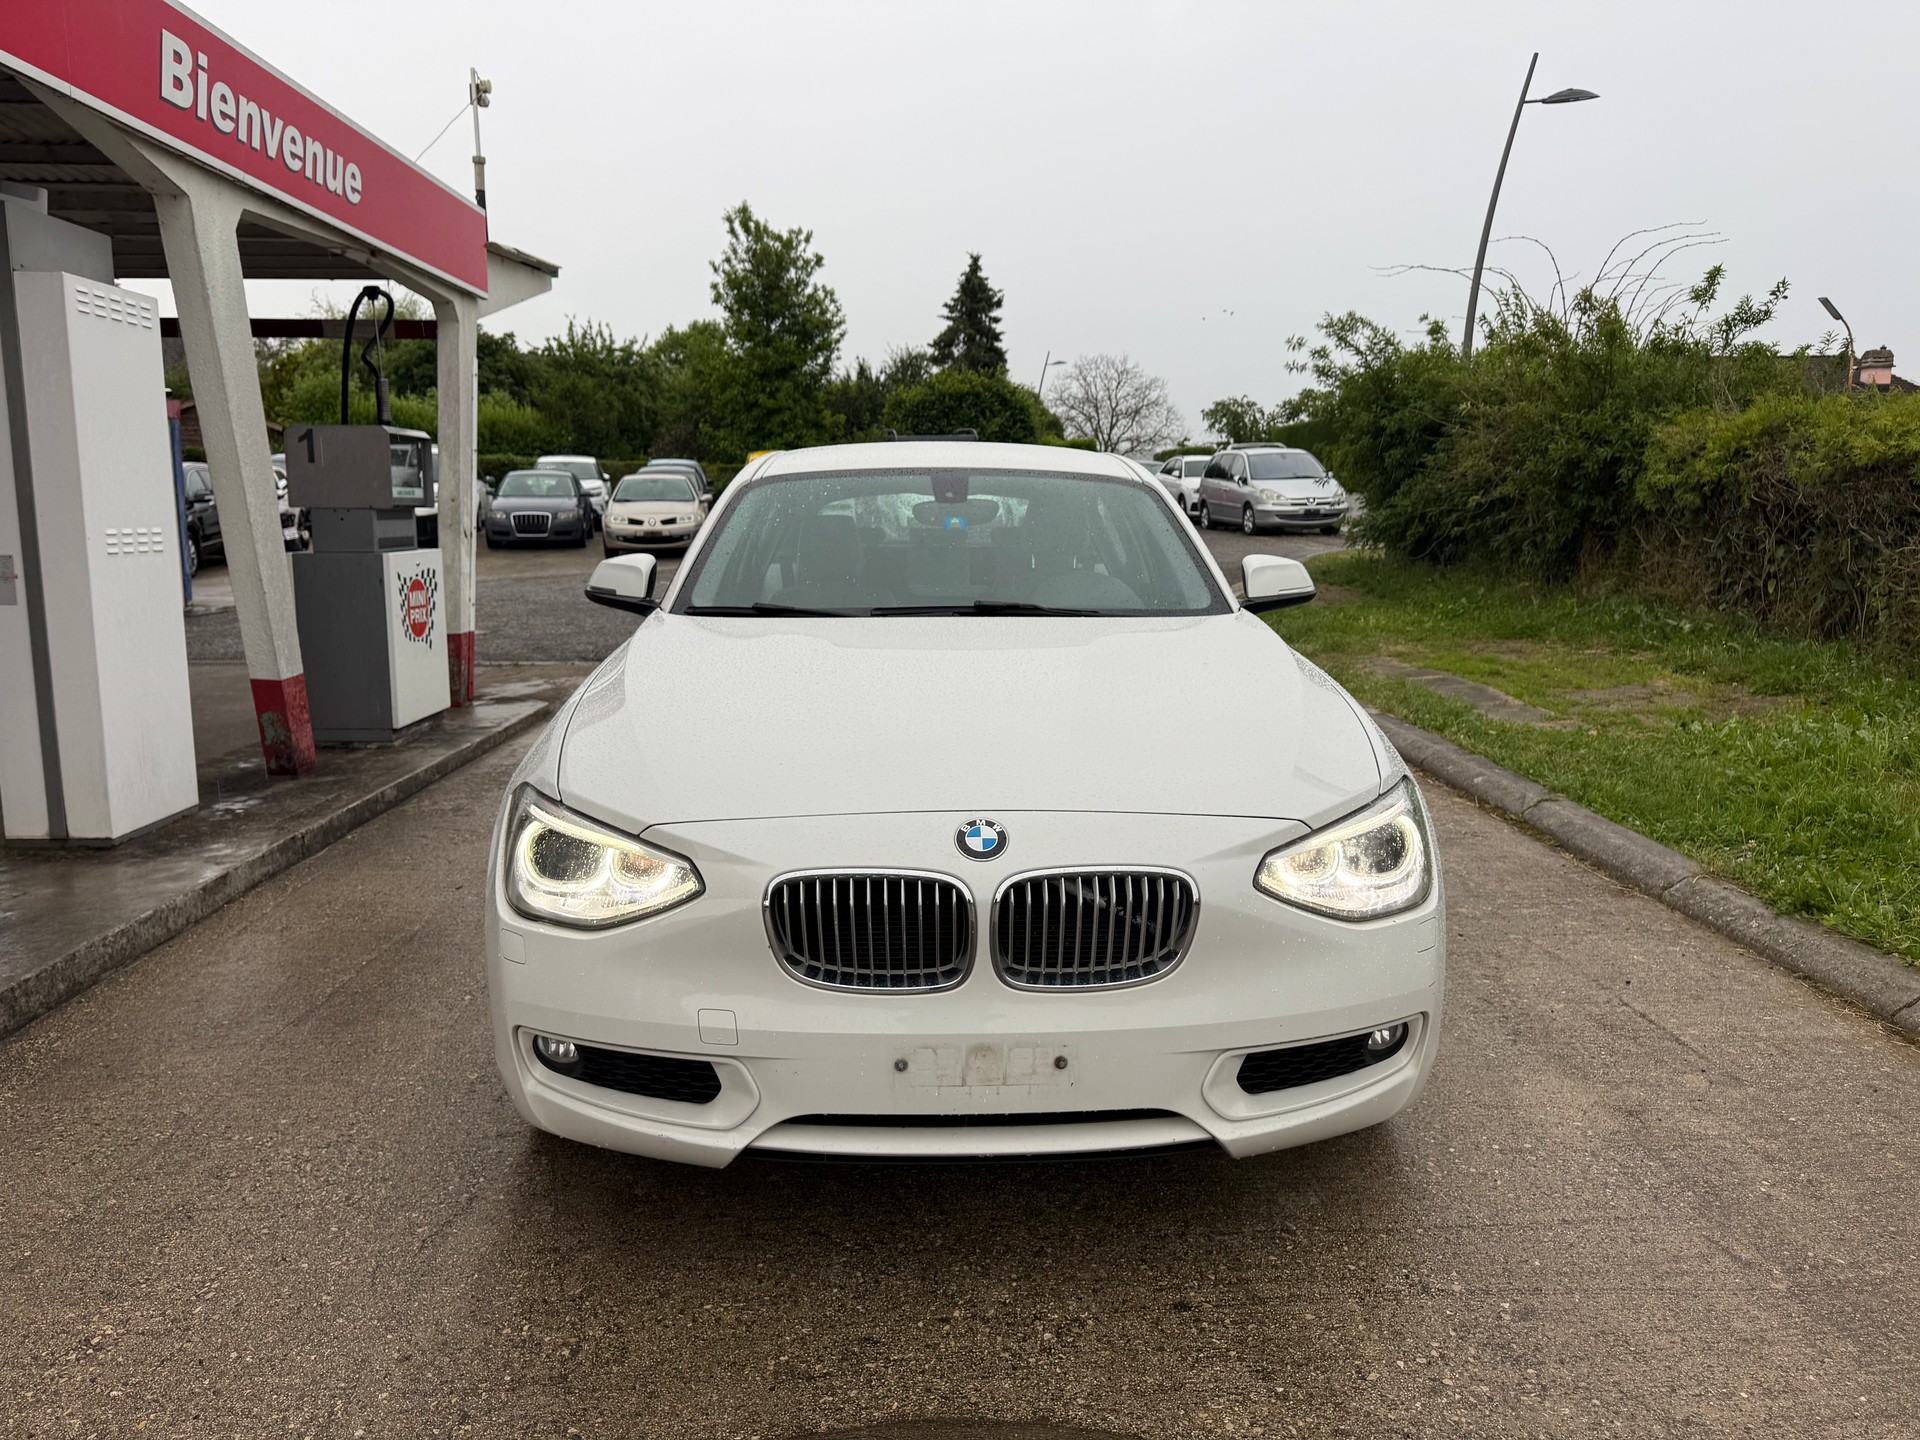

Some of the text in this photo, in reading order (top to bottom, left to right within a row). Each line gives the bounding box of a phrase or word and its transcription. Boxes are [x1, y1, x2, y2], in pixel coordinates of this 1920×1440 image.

[160, 28, 363, 205] Bienvenue
[298, 428, 315, 464] 1
[409, 590, 427, 608] MINI
[410, 607, 428, 625] PRIX
[961, 819, 1002, 832] BMW
